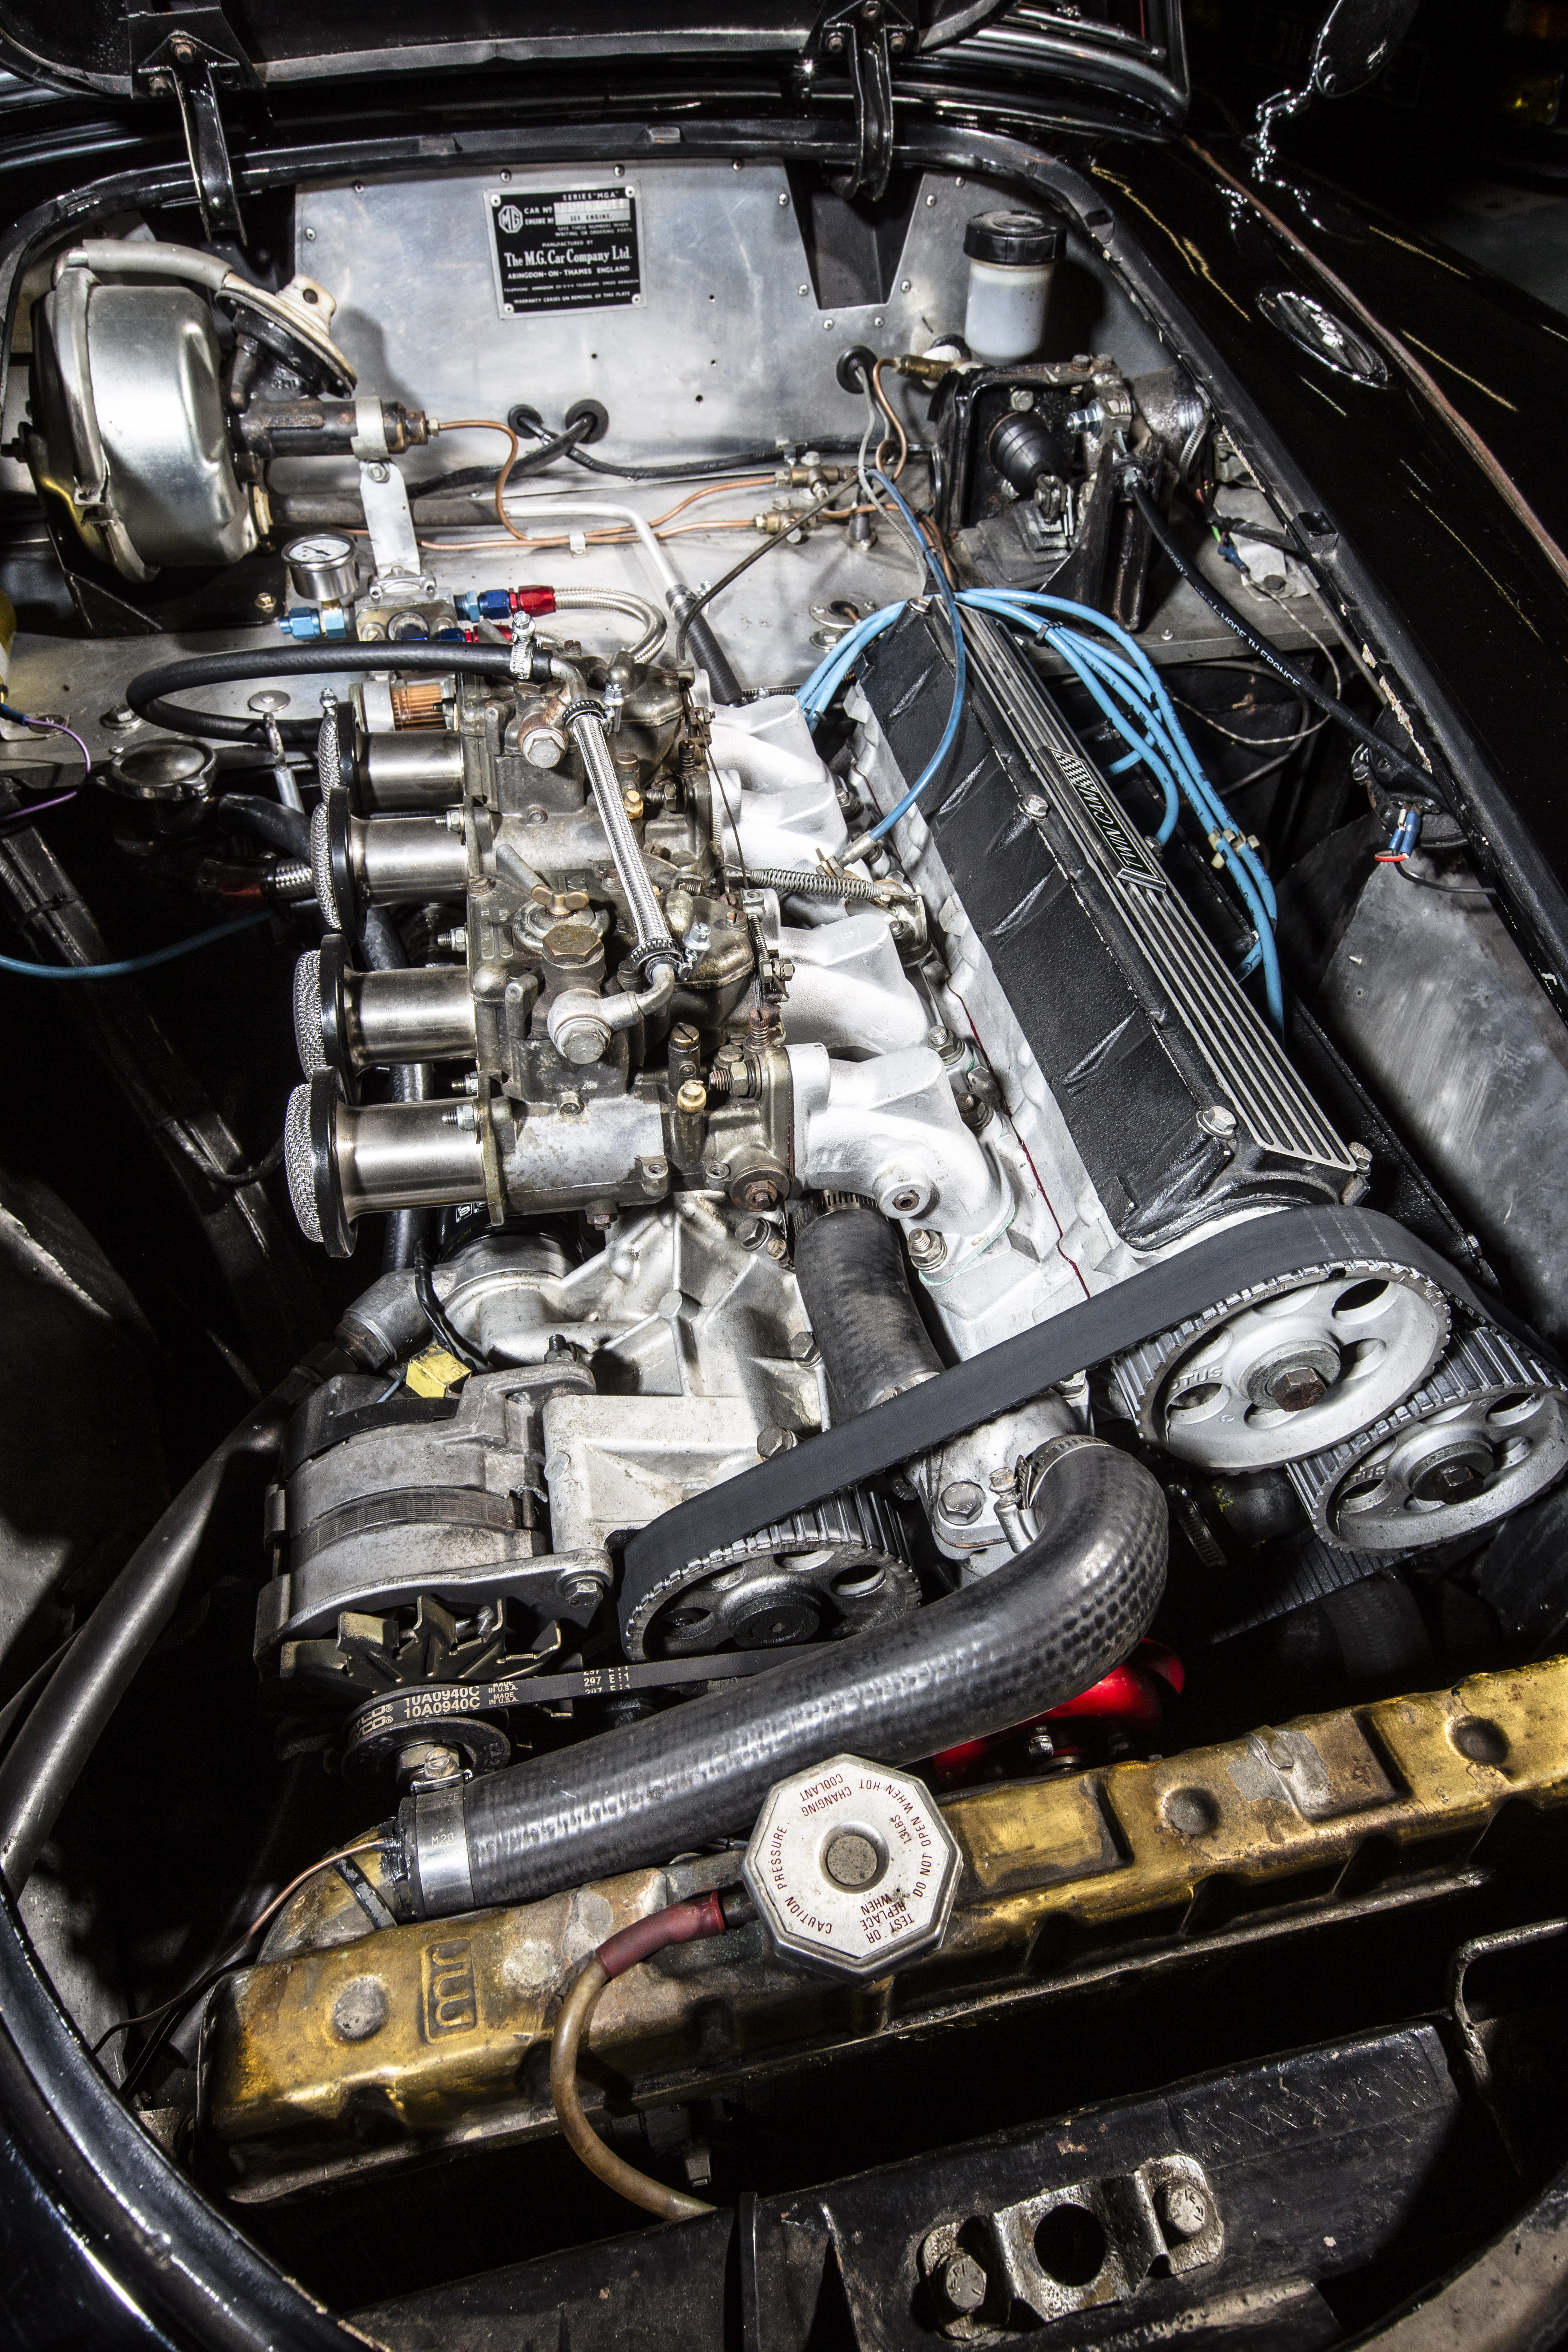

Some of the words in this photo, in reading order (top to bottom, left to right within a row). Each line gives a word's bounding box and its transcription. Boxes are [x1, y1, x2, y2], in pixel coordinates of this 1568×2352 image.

[562, 193, 592, 201] SERIES
[523, 206, 540, 215] CAR
[503, 252, 523, 267] The
[547, 249, 566, 265] Car
[566, 248, 610, 265] Company
[596, 265, 630, 274] ENGLAND
[1079, 788, 1114, 824] CAM
[1102, 825, 1143, 868] TWIN
[584, 1676, 601, 1687] 297
[403, 1696, 481, 1719] 10A0940C
[800, 1773, 843, 1802] COOLANT
[859, 1779, 881, 1791] HOT
[801, 1786, 852, 1817] CHANGING
[884, 1784, 914, 1815] WHEN
[431, 1832, 454, 1848] M20
[911, 1815, 931, 1848] OPEN
[771, 1825, 787, 1890] PRESSURE
[920, 1852, 932, 1876] NOT
[913, 1882, 927, 1898] DO
[785, 1896, 832, 1934] CAUTION
[861, 1894, 892, 1915] WHEN
[860, 1901, 906, 1931] REPLACE
[890, 1913, 915, 1933] TEST
[866, 1929, 882, 1944] OR
